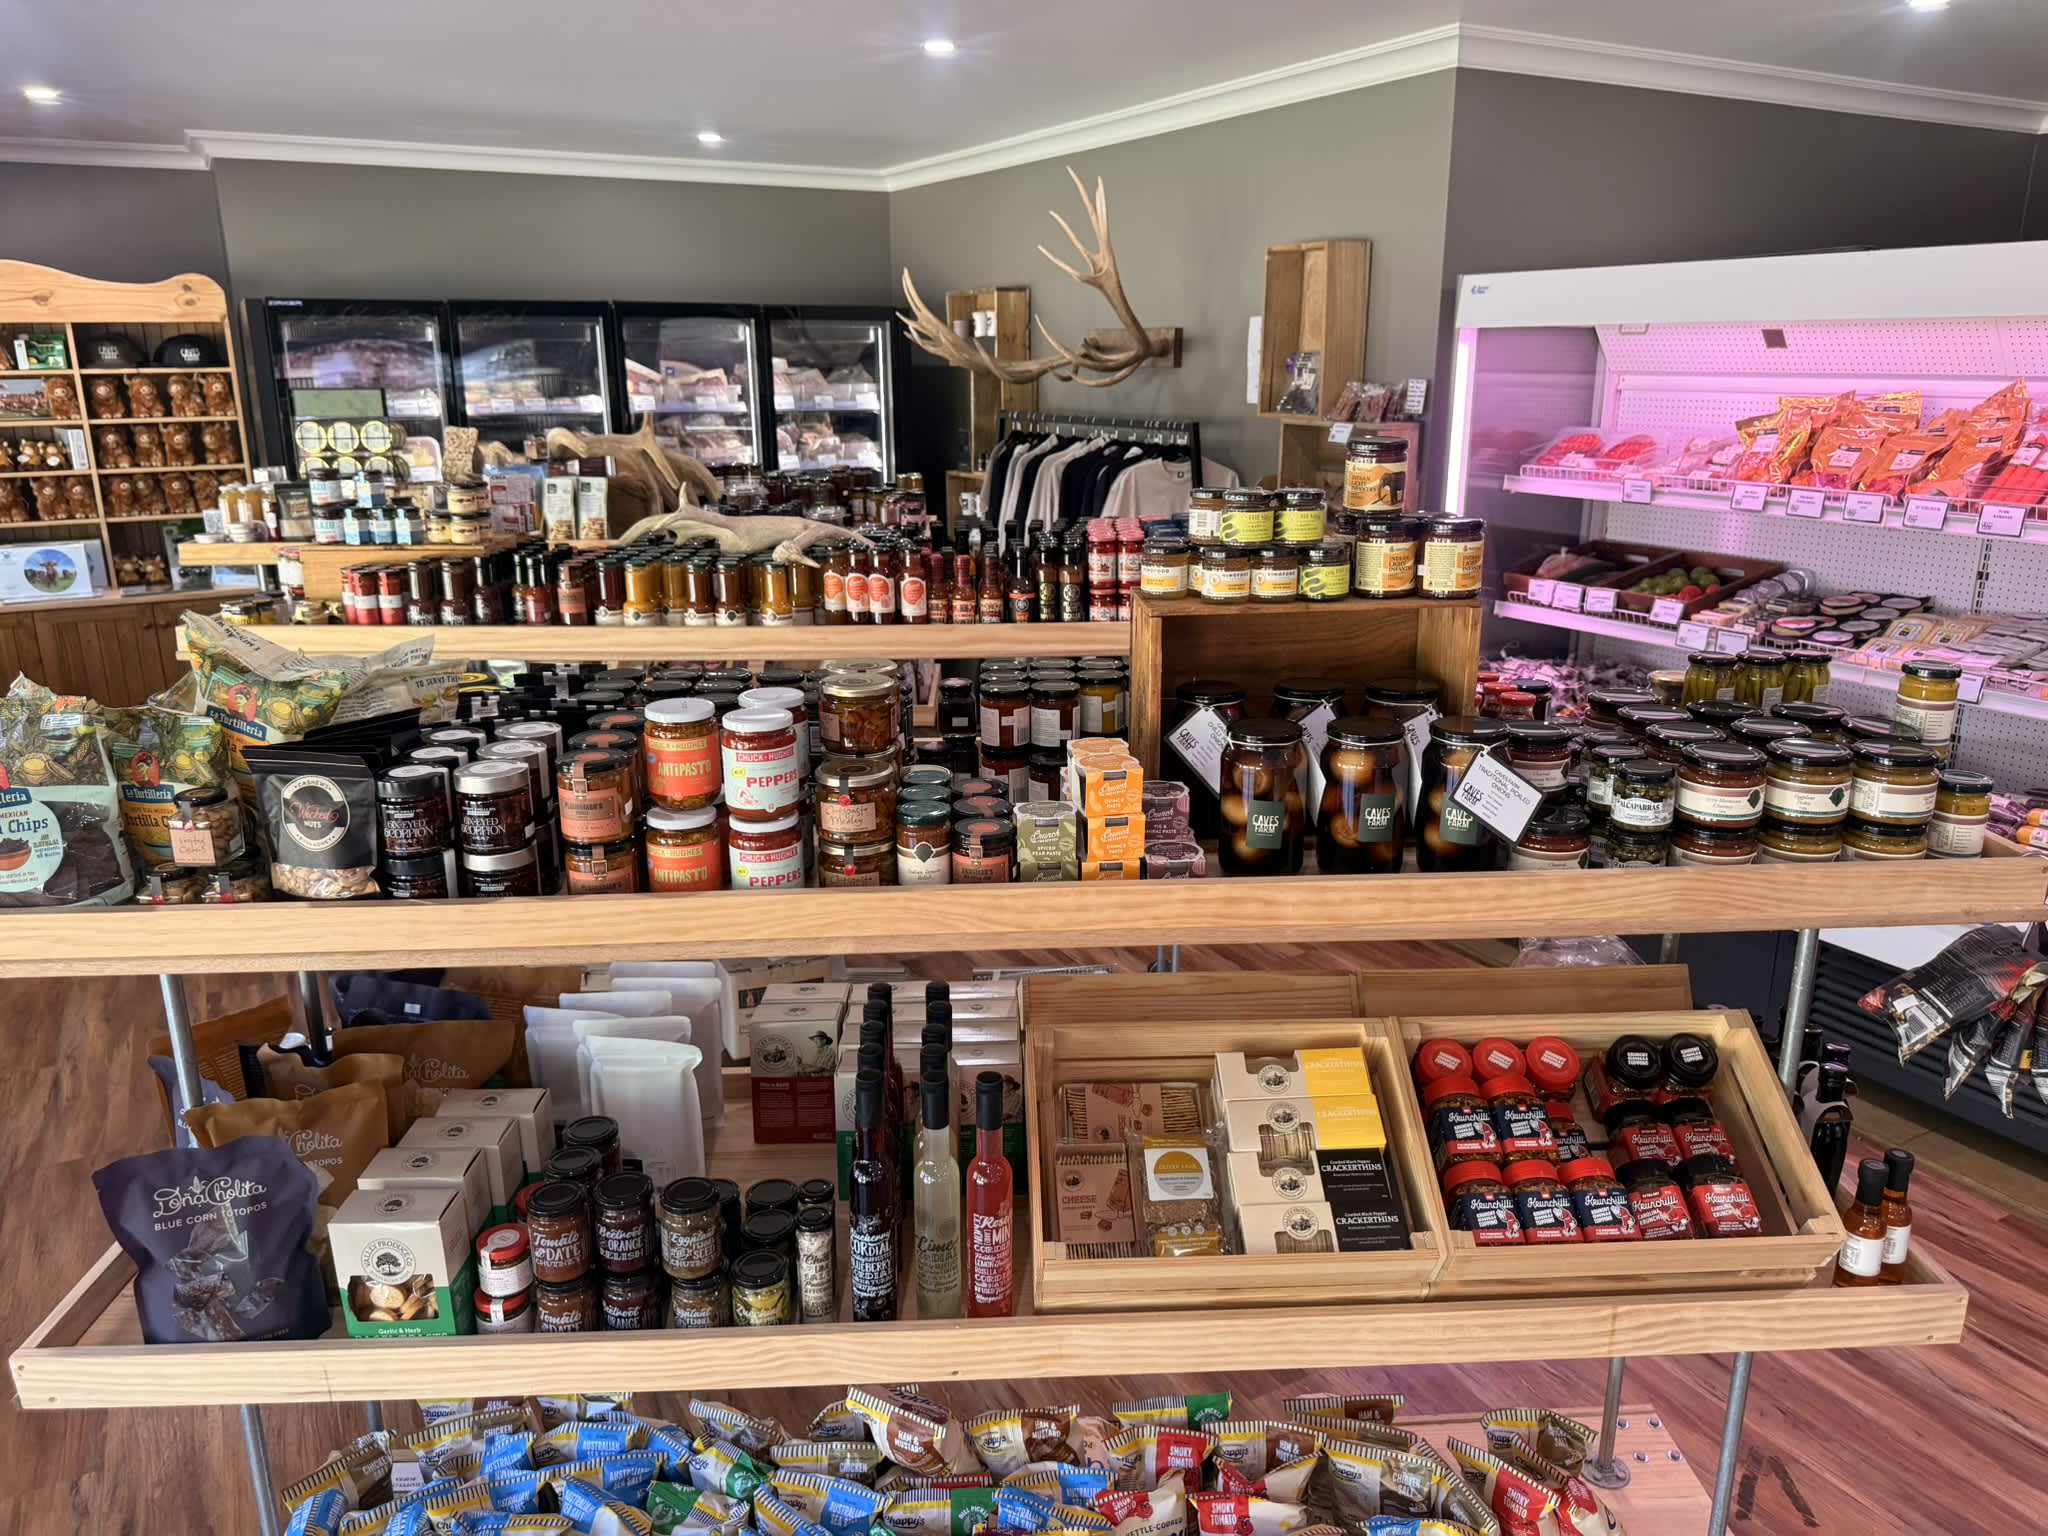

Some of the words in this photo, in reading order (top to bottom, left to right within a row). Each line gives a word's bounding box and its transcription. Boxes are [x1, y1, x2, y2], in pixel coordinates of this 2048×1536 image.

[218, 711, 264, 738] Tortilleria
[1175, 733, 1193, 752] FARM
[1178, 727, 1201, 750] CAVES
[738, 753, 764, 762] CHUCK
[658, 759, 713, 777] ANTIPASTO
[746, 769, 797, 788] PEPPERS
[1477, 763, 1511, 791] TRADITIONAL
[134, 787, 172, 800] Tortilleria
[1099, 782, 1128, 797] Crunch
[1461, 781, 1486, 802] CAVES
[1489, 781, 1513, 800] ONIONS
[1460, 789, 1480, 807] FARM
[1147, 808, 1174, 821] Crunch
[1364, 807, 1391, 819] CAVES
[8, 818, 49, 833] Chips
[303, 820, 322, 829] NUTS
[1252, 814, 1280, 826] CAVES
[1367, 816, 1388, 827] FARM
[1447, 818, 1470, 829] FARM
[383, 826, 434, 839] SCORPION
[461, 824, 506, 836] SCORPION
[1100, 828, 1129, 842] Crunch
[1254, 823, 1277, 834] FARM
[1030, 829, 1060, 842] Crunch
[741, 853, 767, 862] CHUCK
[653, 866, 708, 883] ANTIPASTO
[749, 870, 801, 888] PEPPERS
[288, 1129, 343, 1157] Cholita
[1320, 1163, 1383, 1173] CRACKERTHINS
[205, 1176, 267, 1206] Cholita
[1061, 1194, 1097, 1204] CHEESE
[154, 1217, 183, 1231] BLUE
[186, 1211, 217, 1225] CORN
[221, 1201, 268, 1219] TOTOPOS
[1335, 1215, 1400, 1225] CRACKERTHINS
[599, 1225, 644, 1238] Beetroot
[671, 1227, 715, 1245] Eggplant
[533, 1230, 579, 1247] Tomato
[607, 1238, 644, 1251] ORANGE
[377, 1240, 408, 1258] PRODUCE
[545, 1244, 581, 1261] DATE
[539, 1310, 582, 1325] Tomato
[1358, 1410, 1371, 1420] HAM
[484, 1424, 513, 1437] CHICKEN
[1034, 1419, 1049, 1430] HAM
[1050, 1421, 1057, 1431] &
[897, 1430, 912, 1443] HAM
[912, 1436, 920, 1445] &
[1031, 1429, 1061, 1440] MUSTARD
[583, 1440, 620, 1451] AUSTRALIAN
[894, 1437, 925, 1454] MUSTARD
[1169, 1446, 1193, 1457] SMOKY
[1279, 1439, 1292, 1451] HAM
[485, 1449, 523, 1473] AUSTRALIAN
[839, 1461, 868, 1473] CHICKEN
[1167, 1457, 1194, 1468] TOMATO
[609, 1466, 651, 1482] AUSTRALIAN
[1506, 1487, 1530, 1508] SMOKY
[829, 1501, 867, 1518] AUSTRALIAN
[957, 1508, 970, 1519] DILL
[1210, 1502, 1235, 1514] SMOKY
[1503, 1497, 1528, 1521] TOMATO
[1210, 1513, 1238, 1526] TOMATO
